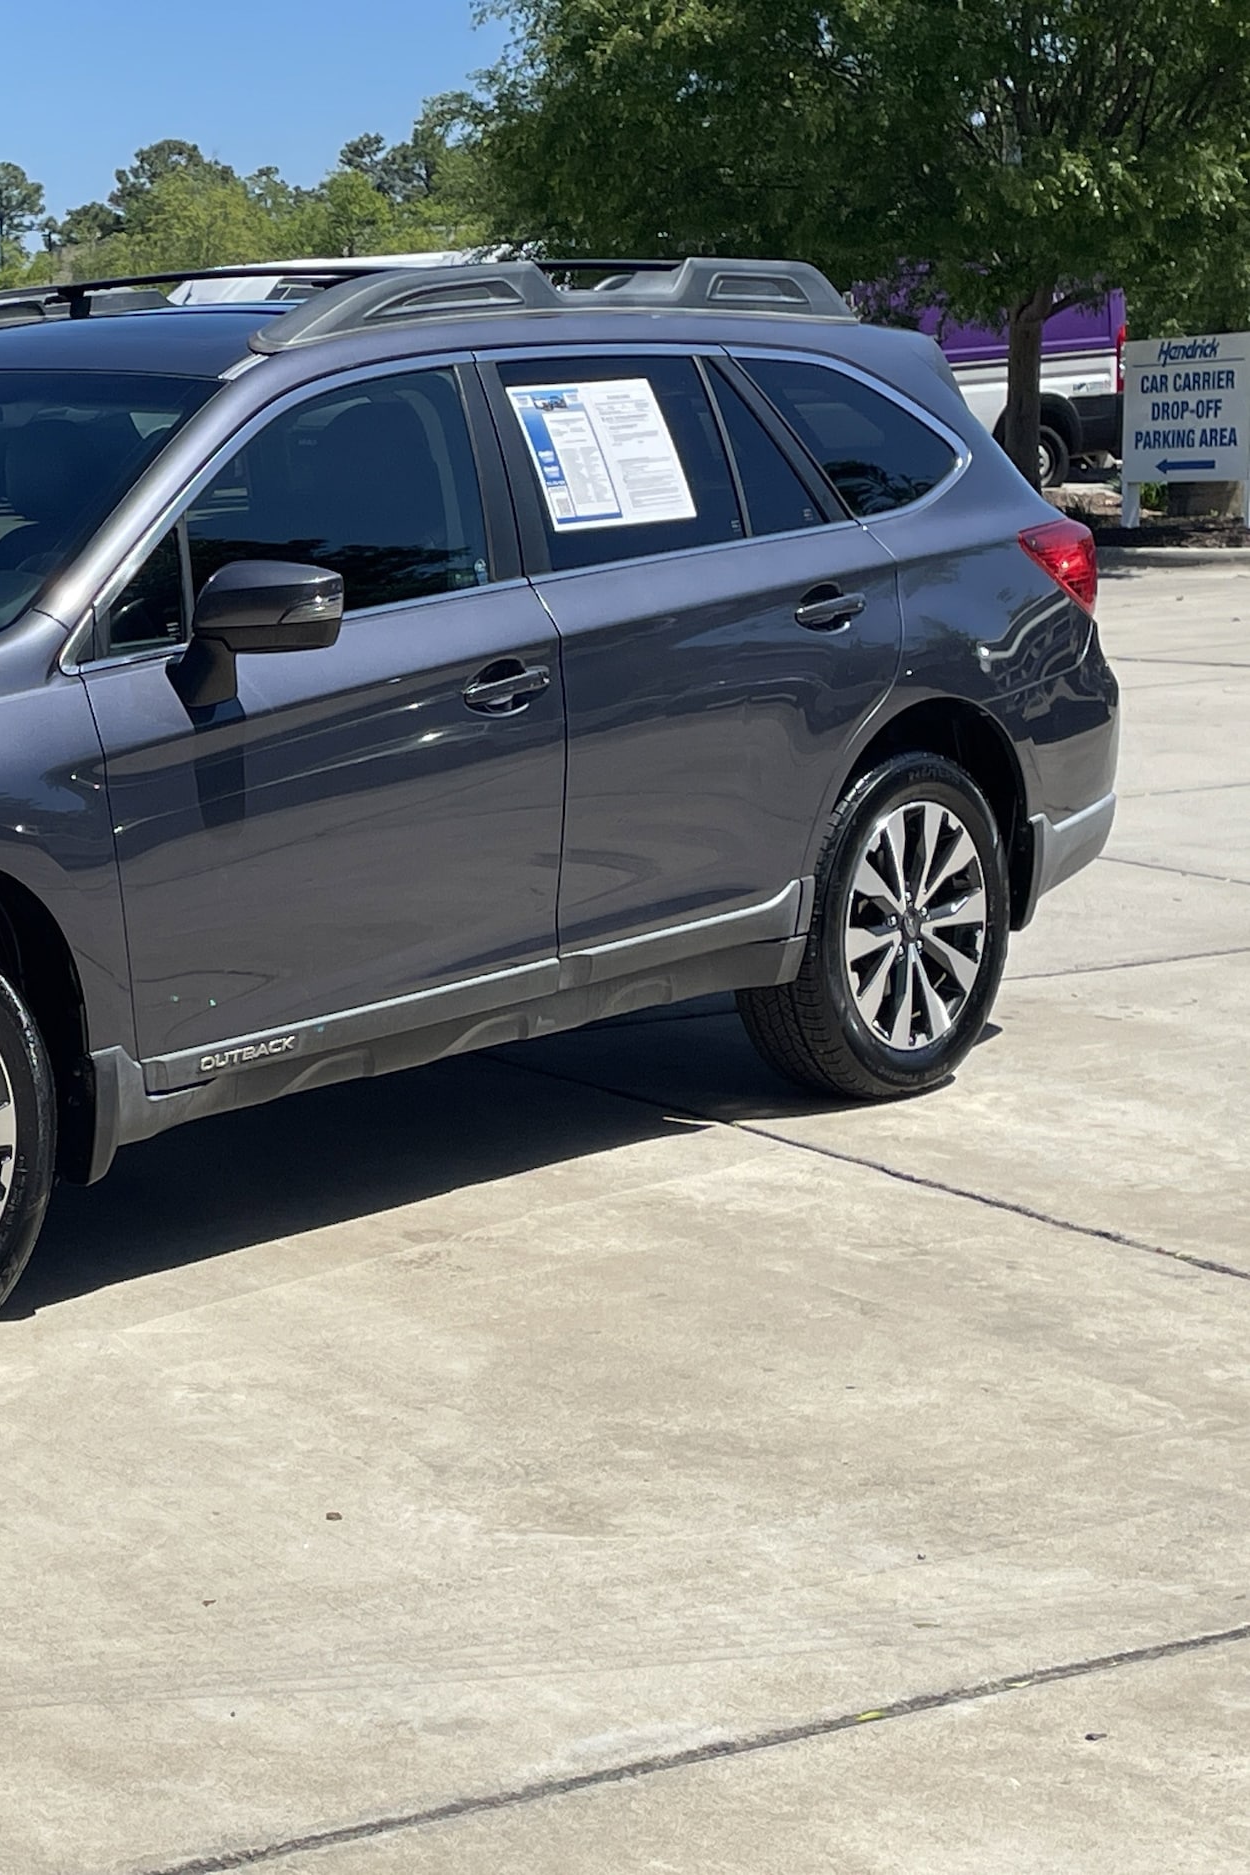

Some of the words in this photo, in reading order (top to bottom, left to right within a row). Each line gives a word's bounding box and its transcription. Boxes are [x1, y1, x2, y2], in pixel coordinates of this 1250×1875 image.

[1157, 337, 1220, 367] Hendrick
[1140, 373, 1169, 394] CAR
[1173, 370, 1235, 392] CARRIER
[1151, 399, 1222, 421] DROP-OFF
[1134, 429, 1195, 450] PARKING
[1199, 427, 1238, 448] AREA
[200, 1035, 295, 1071] OUTBACK
